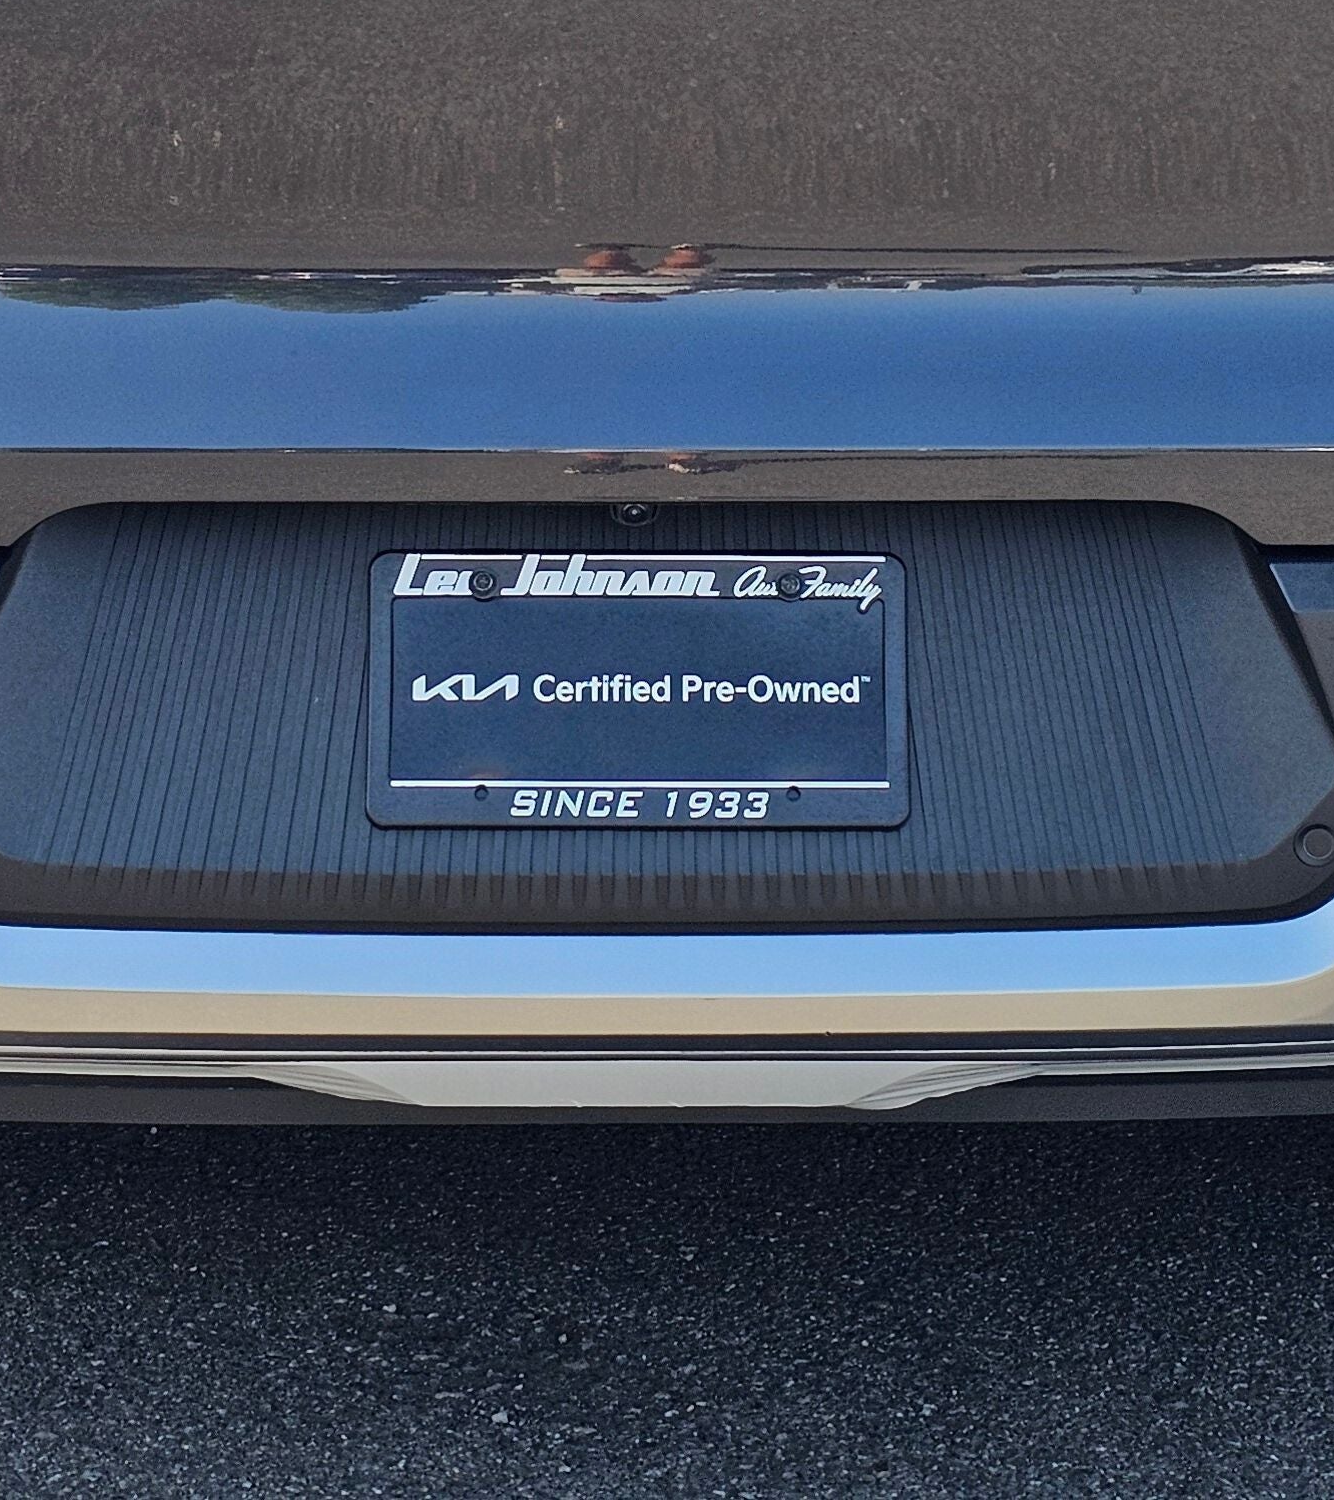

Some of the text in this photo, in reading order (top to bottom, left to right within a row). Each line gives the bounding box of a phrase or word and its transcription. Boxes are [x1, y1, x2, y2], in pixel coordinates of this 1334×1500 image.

[500, 553, 721, 597] Johnson
[798, 565, 883, 612] Family
[411, 673, 520, 702] KIA
[532, 673, 672, 704] Certified
[509, 789, 771, 819] SINCE 1933
